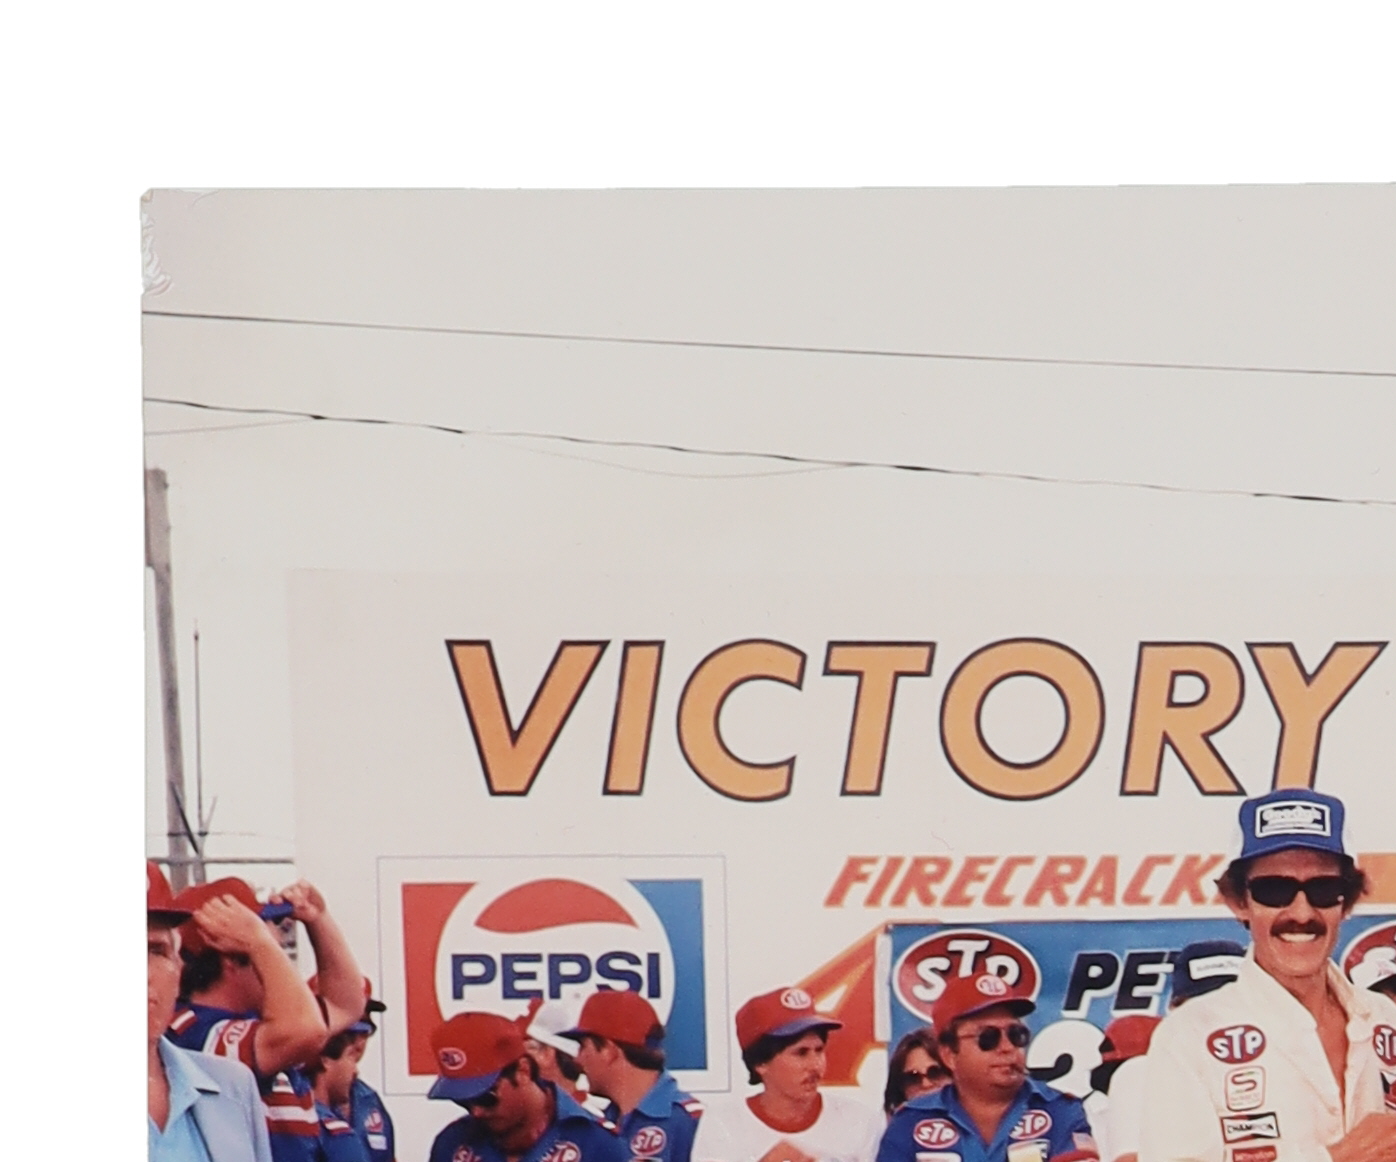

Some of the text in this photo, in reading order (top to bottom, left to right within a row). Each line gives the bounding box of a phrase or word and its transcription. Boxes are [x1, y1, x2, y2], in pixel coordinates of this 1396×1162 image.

[445, 637, 1390, 802] VICTORY
[823, 854, 1228, 908] FIRECRACK
[450, 951, 661, 1001] PEPSI
[913, 938, 1020, 1004] STP
[1211, 1027, 1265, 1061] STP
[917, 1122, 956, 1143] STP
